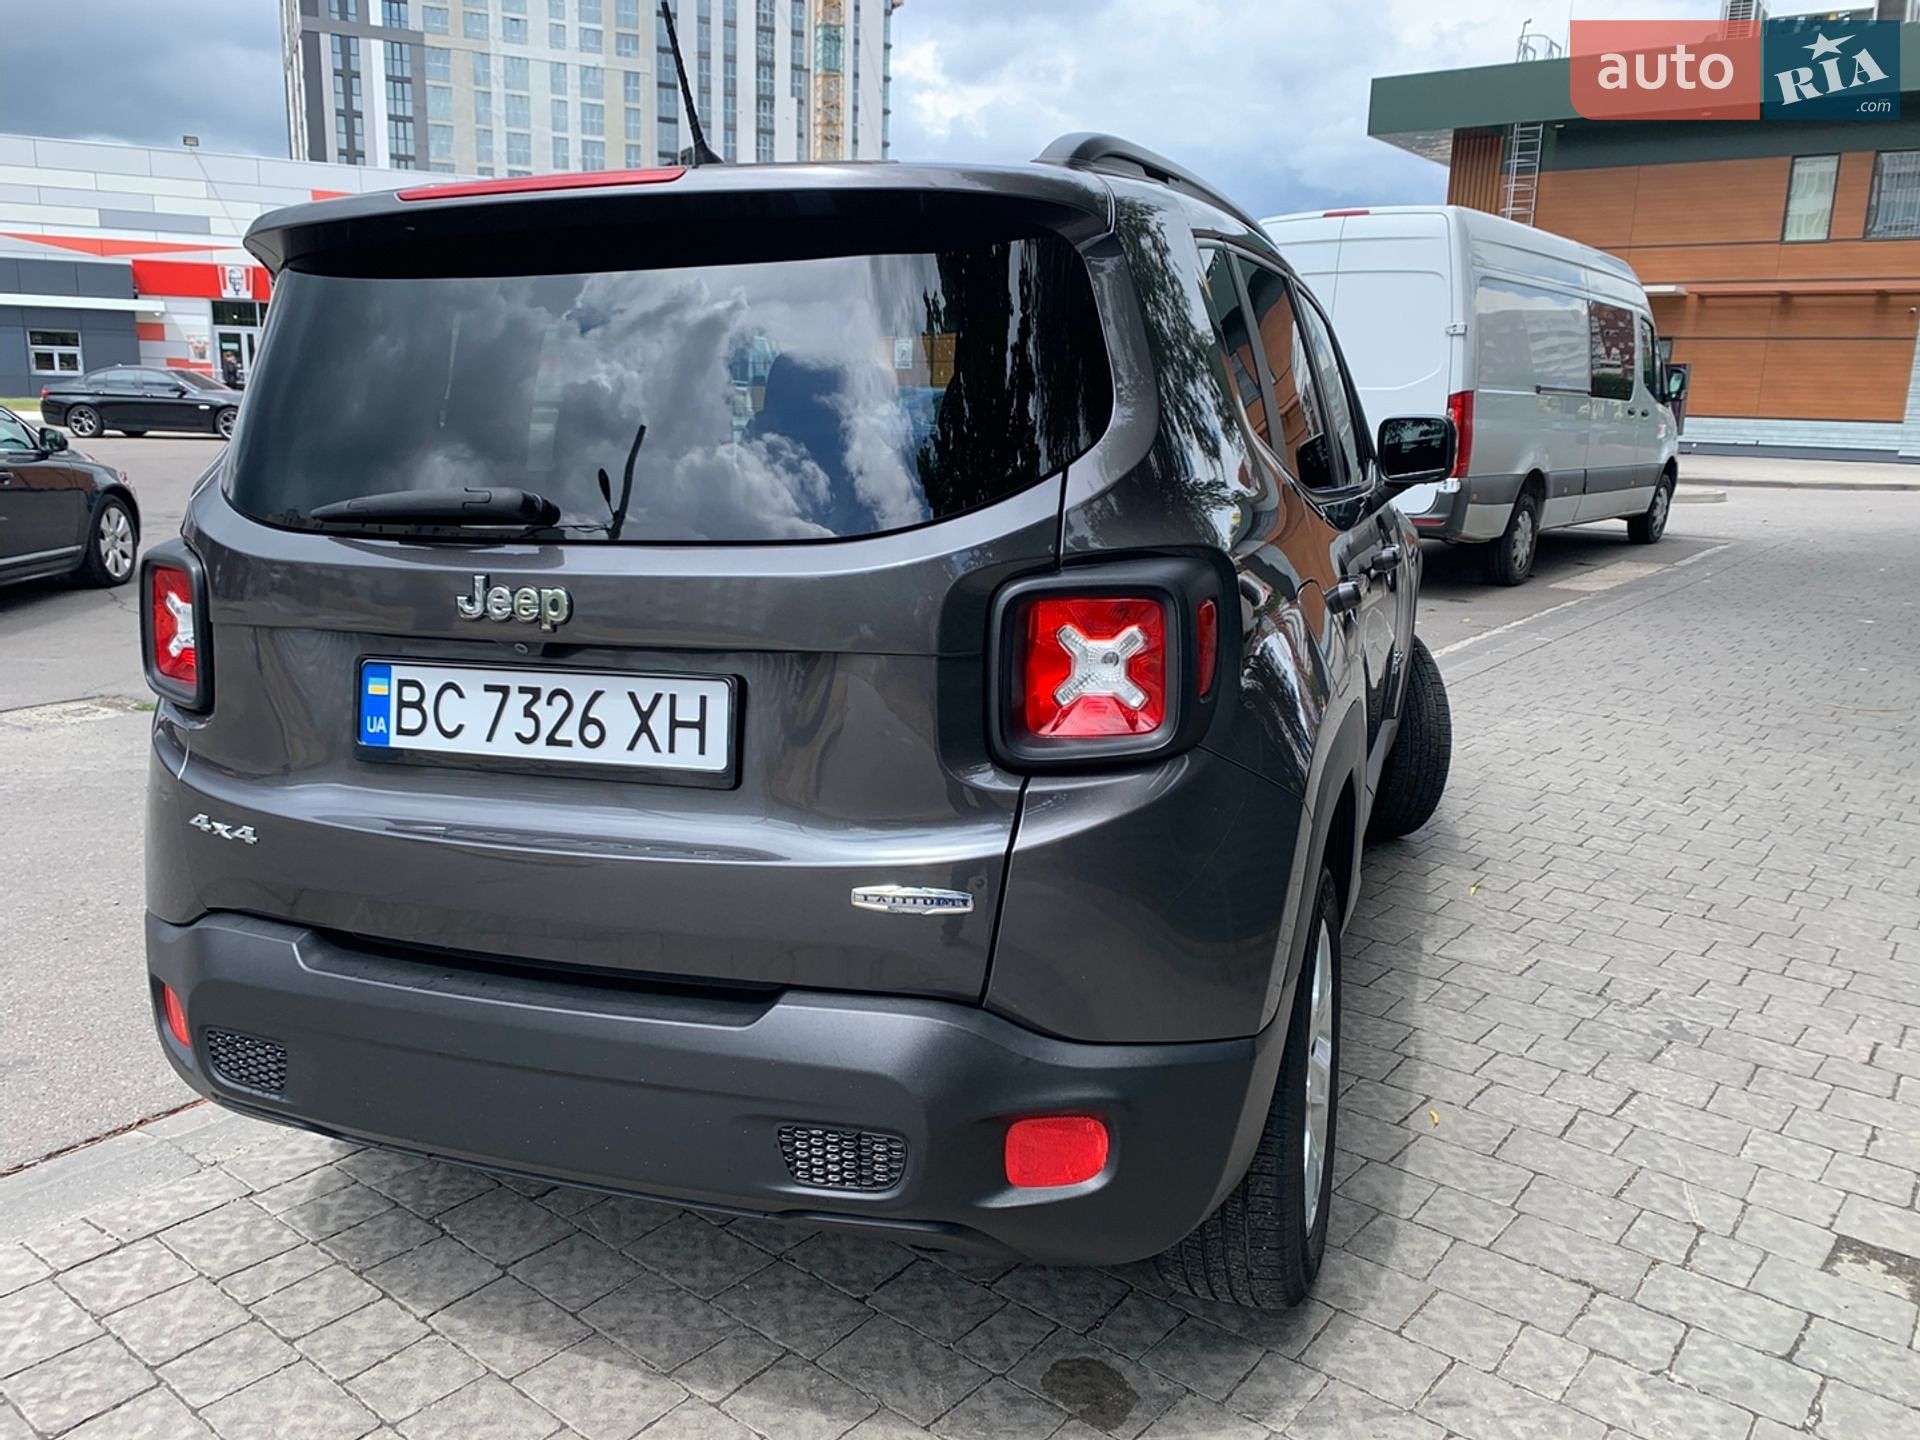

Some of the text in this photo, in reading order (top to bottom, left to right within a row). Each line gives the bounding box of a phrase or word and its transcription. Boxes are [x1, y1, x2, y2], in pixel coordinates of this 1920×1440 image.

[456, 574, 573, 632] Jeep
[366, 715, 388, 733] UA
[396, 678, 708, 755] BC 7326 XH
